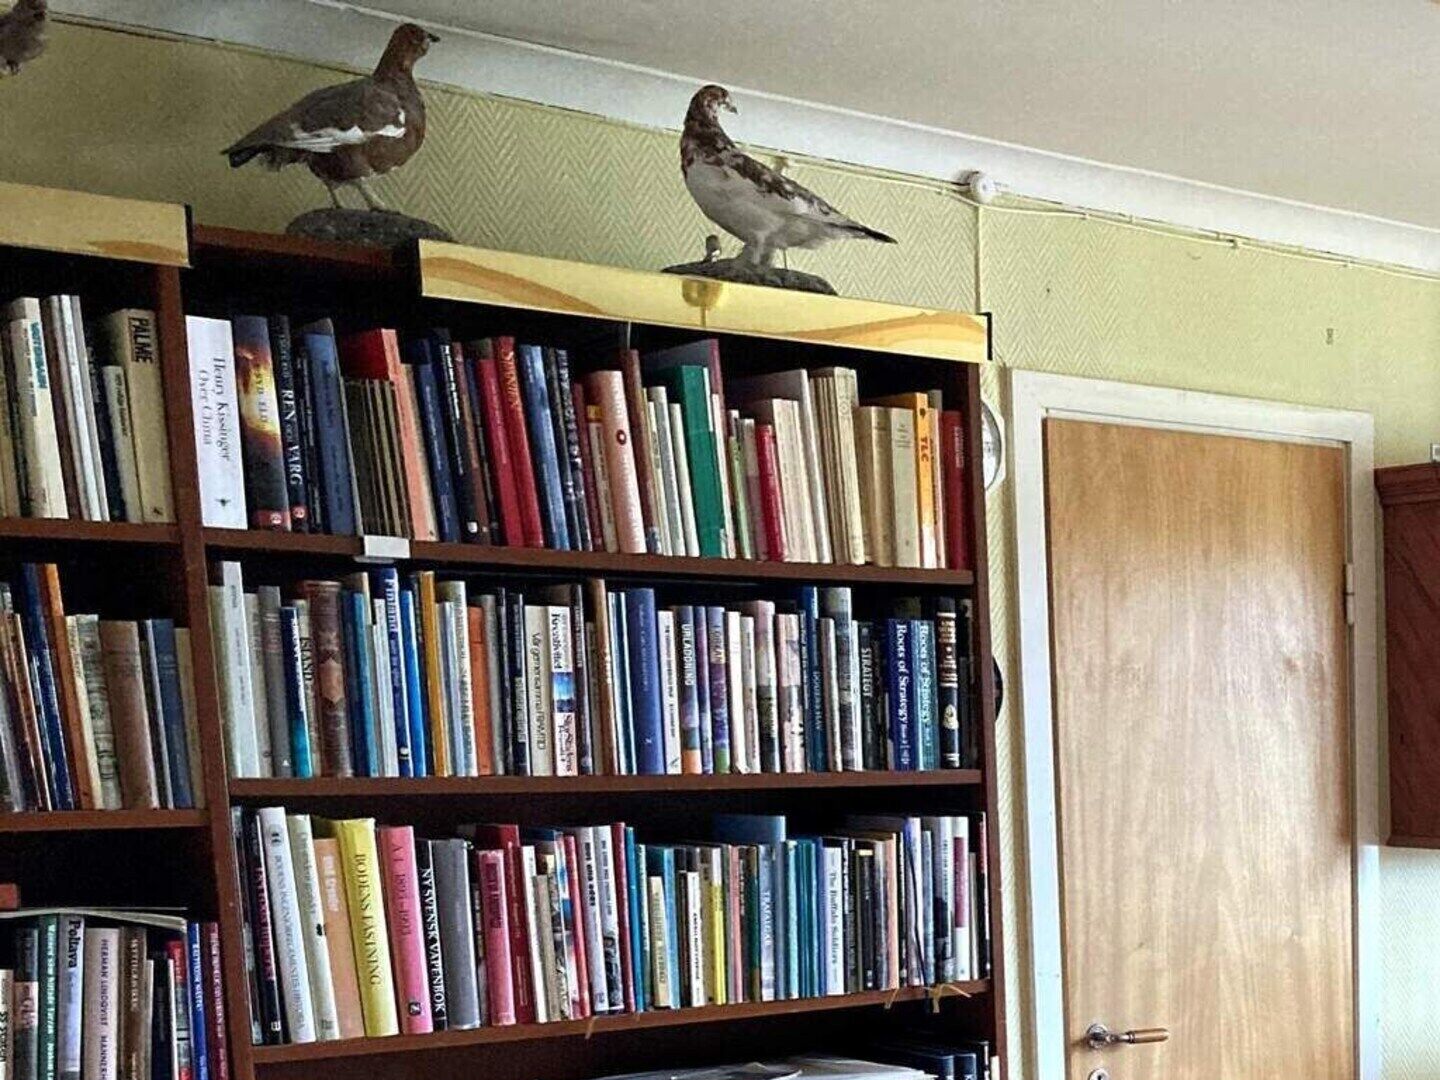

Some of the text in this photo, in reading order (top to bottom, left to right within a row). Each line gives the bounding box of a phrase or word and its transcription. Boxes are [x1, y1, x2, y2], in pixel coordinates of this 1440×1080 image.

[200, 405, 214, 445] China
[211, 357, 232, 461] Henry Kissinger
[286, 444, 303, 486] VARG
[896, 624, 907, 656] Roots
[919, 624, 930, 657] Roots
[861, 647, 872, 698] STRATEGY
[898, 660, 908, 673] of
[921, 662, 930, 674] of
[896, 675, 909, 723] Strategy
[920, 676, 931, 722] Strategy
[354, 853, 371, 911] BODENS
[420, 868, 445, 1012] NYSVENSK VAPENBOK
[829, 872, 839, 964] The Buffalo Soldiers
[67, 919, 81, 968] Poltava
[100, 939, 108, 977] HERMAN
[99, 980, 107, 1025] LINDQVIST
